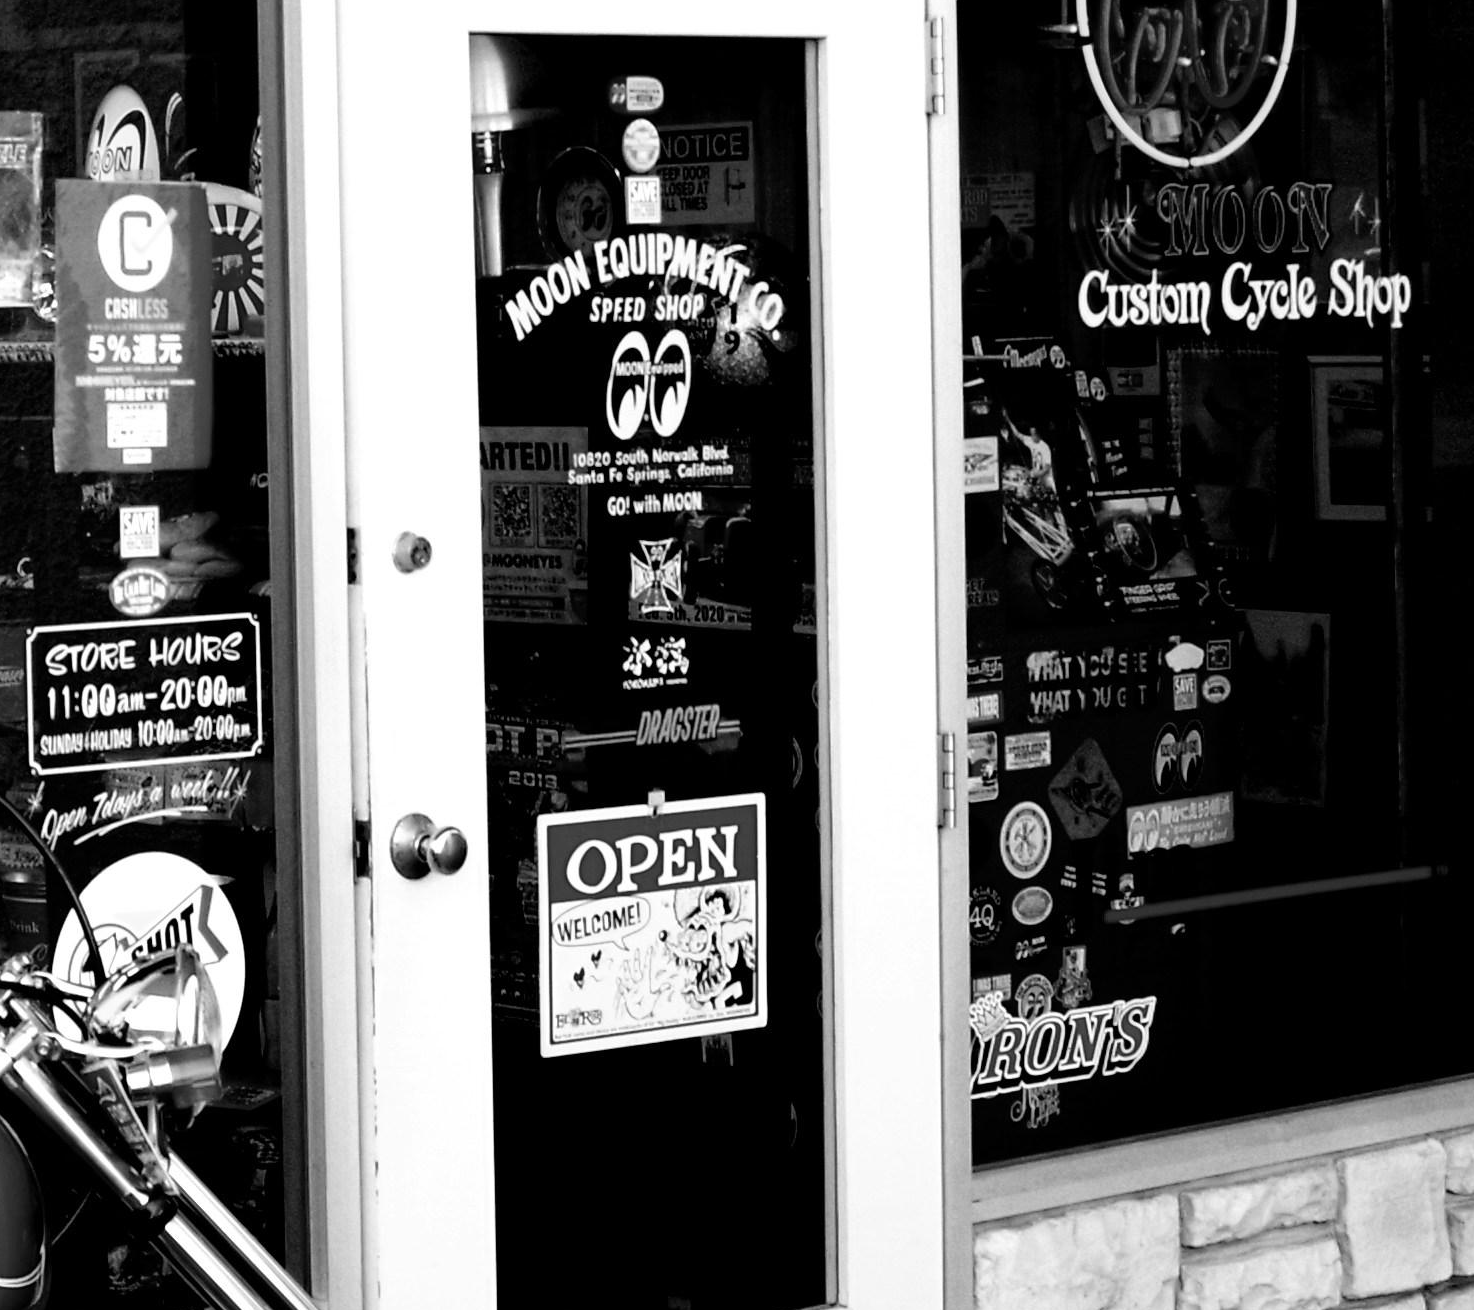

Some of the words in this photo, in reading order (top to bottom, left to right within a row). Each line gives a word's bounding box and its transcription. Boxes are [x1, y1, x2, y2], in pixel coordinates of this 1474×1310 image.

[630, 181, 657, 202] SAVE
[1158, 182, 1332, 257] MOON
[505, 250, 591, 341] MOON
[594, 233, 751, 303] EQUIPMENT
[749, 281, 784, 341] CO.
[1077, 269, 1211, 335] Custom
[1221, 261, 1317, 331] Cycle
[1327, 257, 1411, 328] Shop
[105, 297, 168, 320] CASHLESS
[589, 296, 646, 323] SPEED
[654, 294, 703, 321] SHOP
[616, 362, 644, 376] MOON
[568, 469, 604, 485] Santa
[609, 467, 623, 482] Fe
[677, 461, 734, 478] California
[573, 451, 611, 467] 10820
[615, 447, 649, 466] South
[652, 446, 699, 463] Norwalk
[607, 496, 630, 516] GO!
[633, 494, 661, 514] with
[662, 491, 702, 512] MOON
[124, 512, 155, 535] SAVE
[45, 640, 137, 676] STORE
[148, 632, 243, 667] HOURS
[636, 703, 720, 746] DRAGSTER
[40, 806, 87, 851] Open
[92, 789, 144, 825] 7days
[150, 786, 163, 802] a
[566, 825, 739, 894] OPEN
[557, 902, 642, 943] WELCOME!
